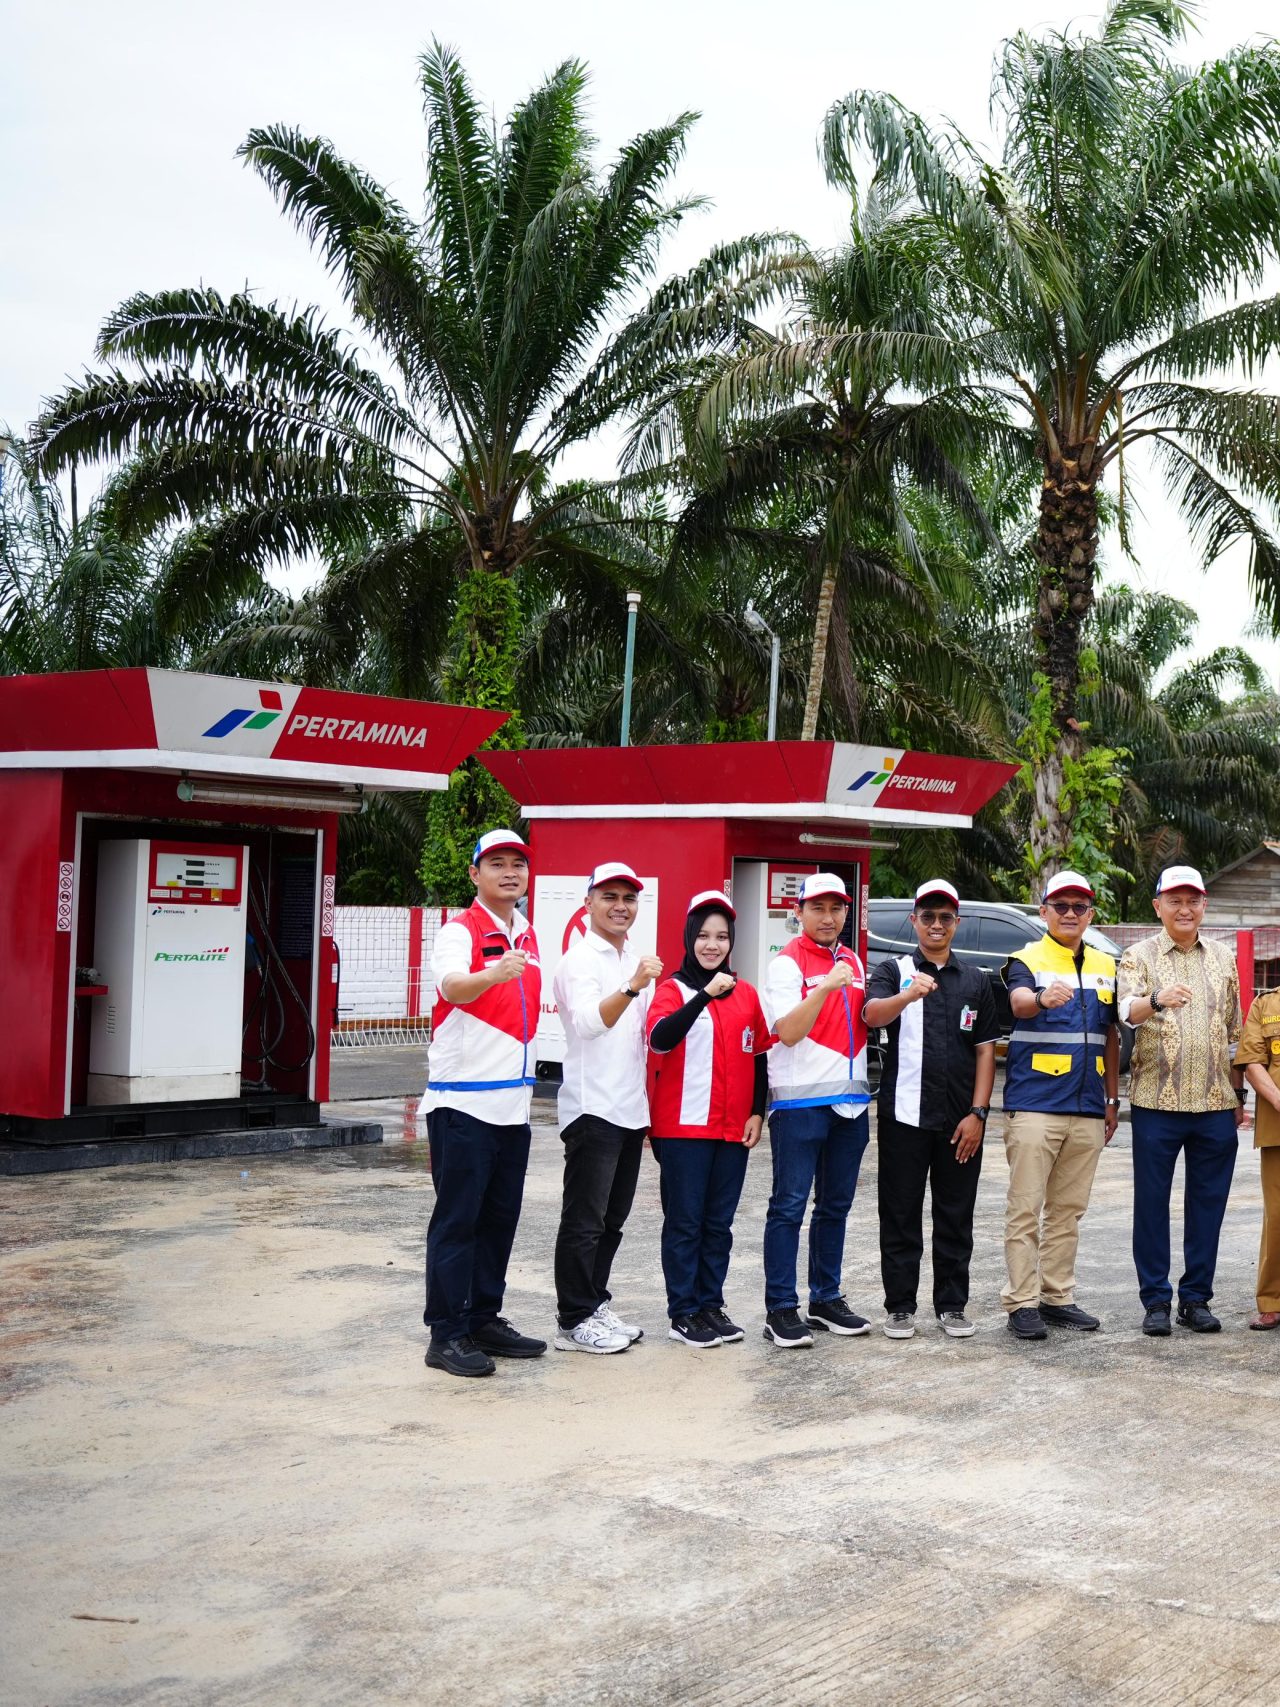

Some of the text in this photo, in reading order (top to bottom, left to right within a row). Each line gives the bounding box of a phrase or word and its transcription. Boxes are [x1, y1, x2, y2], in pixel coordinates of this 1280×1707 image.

[287, 714, 428, 748] PERTAMINA
[888, 774, 957, 794] PERTAMINA
[154, 952, 228, 962] PERTALITE
